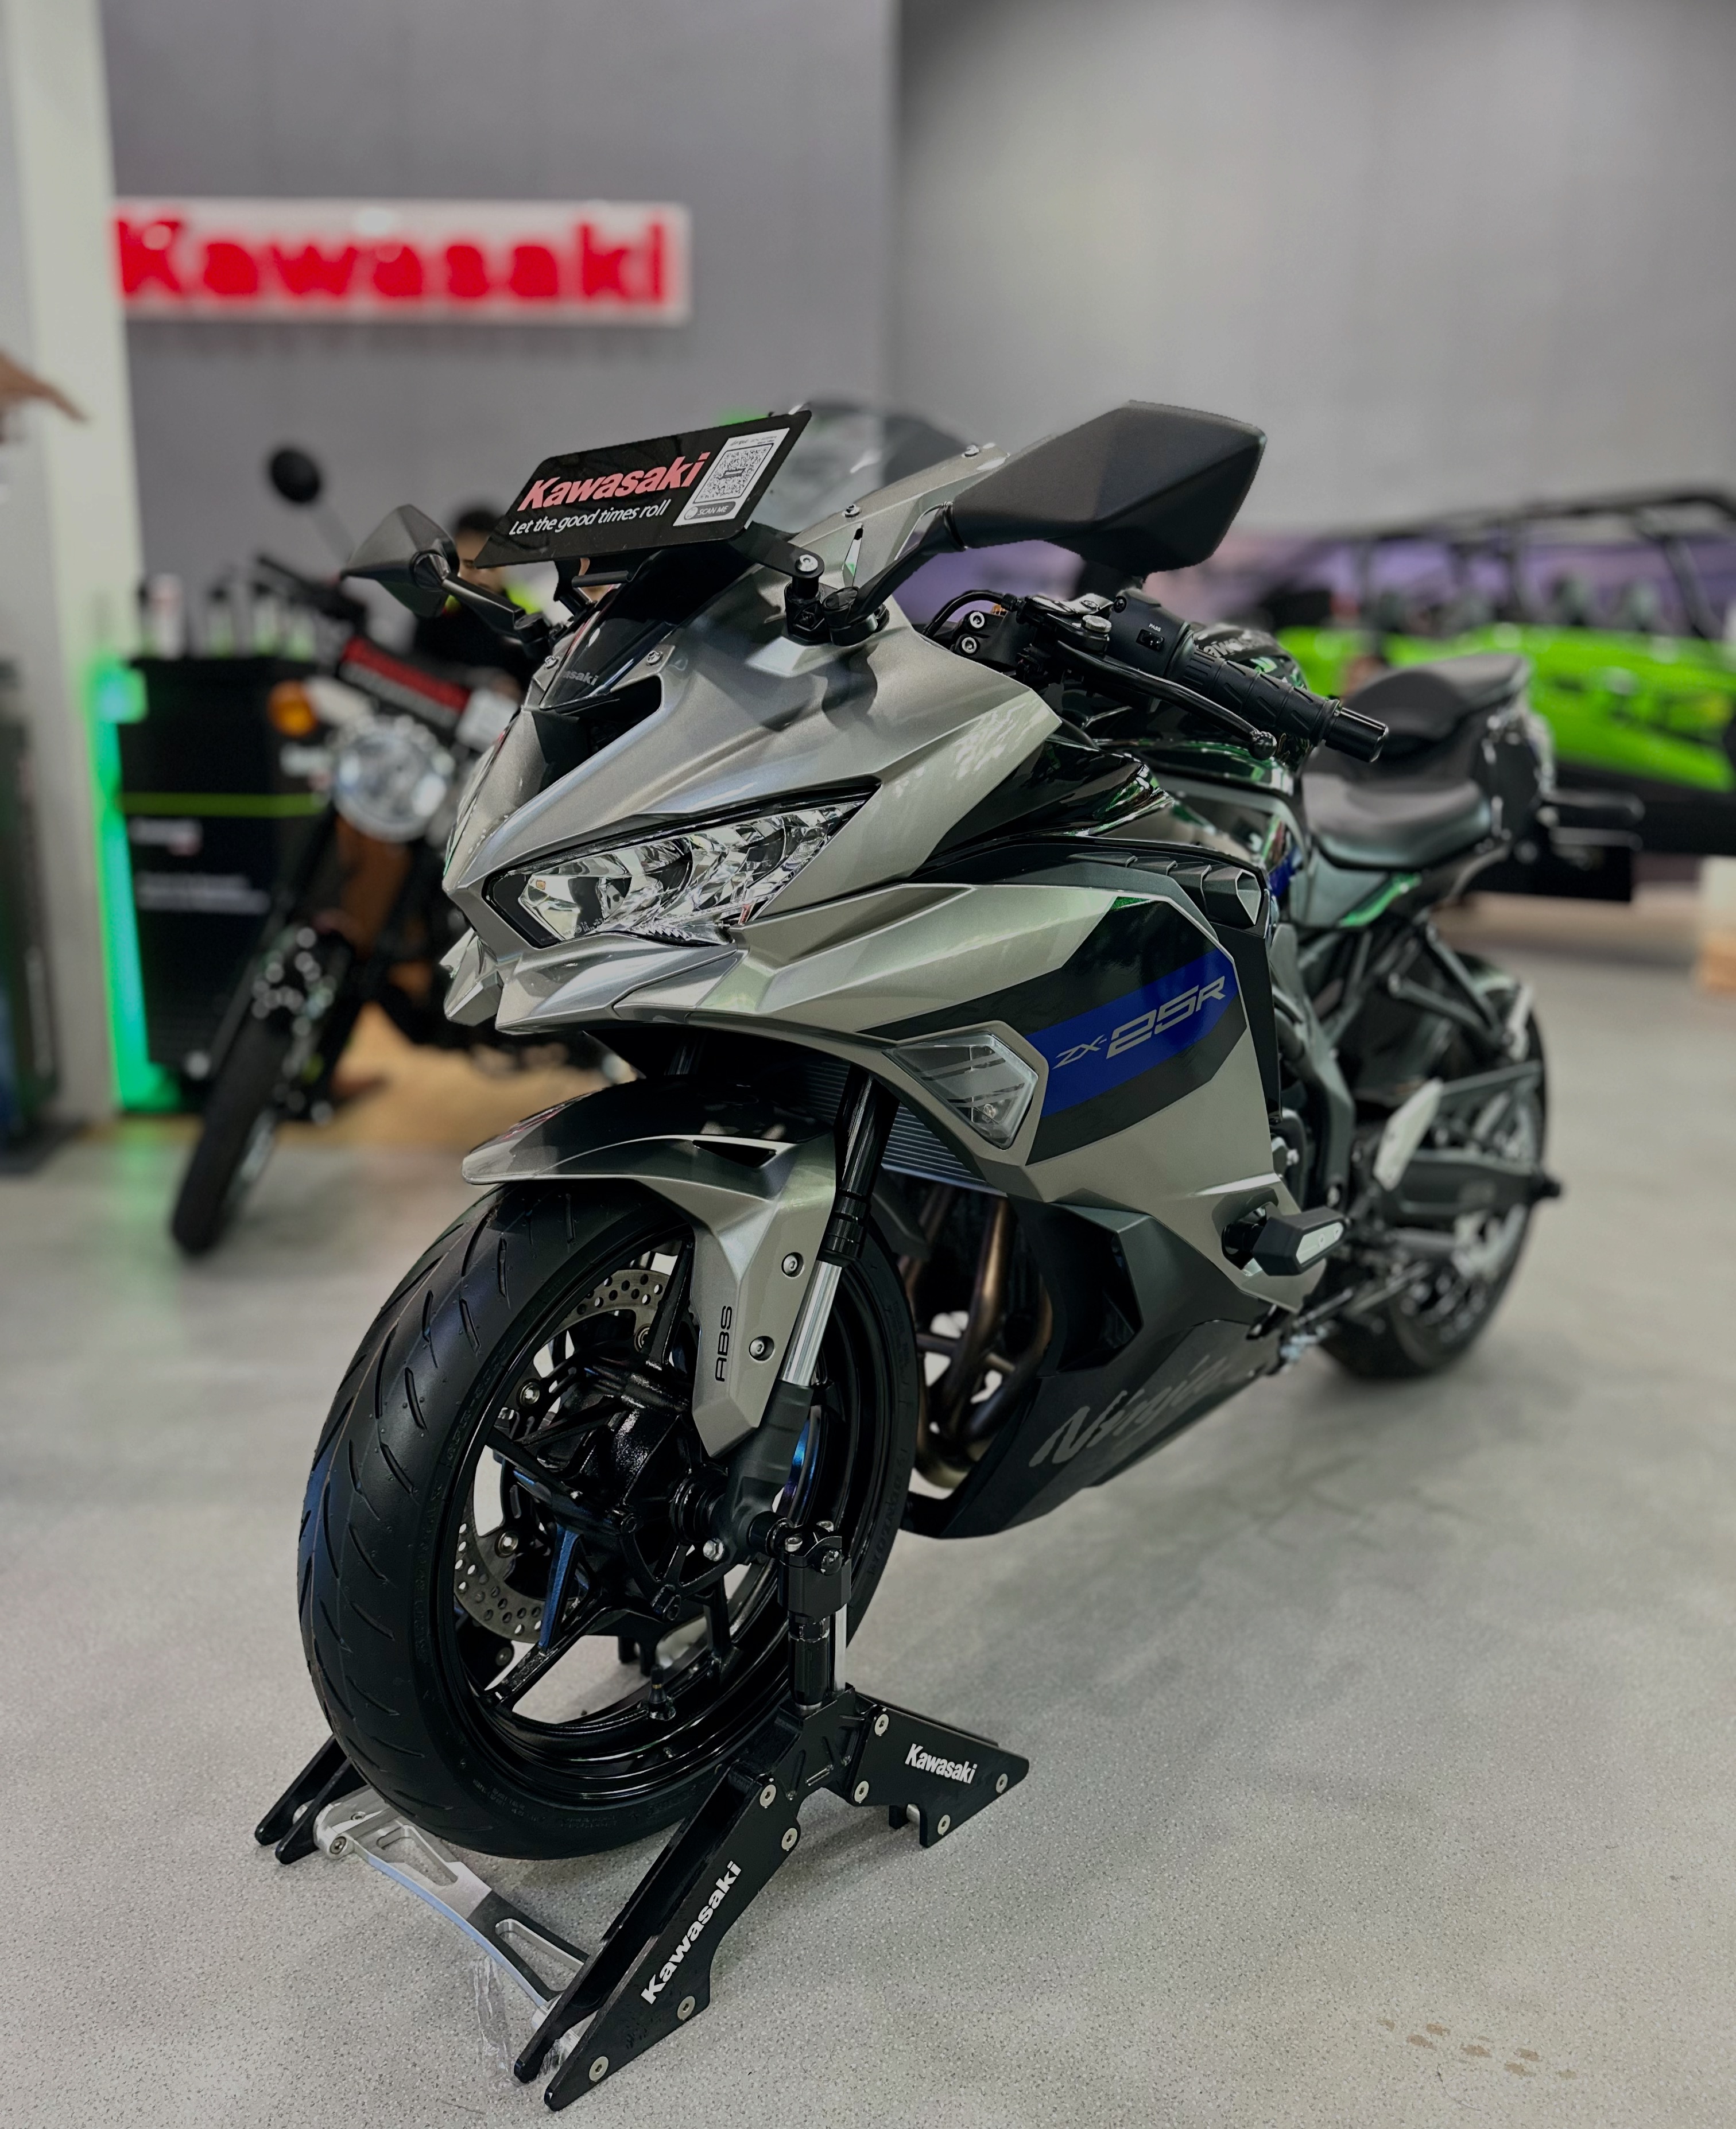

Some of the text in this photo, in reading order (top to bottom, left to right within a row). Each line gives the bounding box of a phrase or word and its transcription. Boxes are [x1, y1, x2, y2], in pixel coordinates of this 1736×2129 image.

[116, 219, 666, 298] Kawasaki
[517, 452, 711, 511] Kawasaki
[698, 505, 729, 516] SCAN ME
[509, 498, 672, 535] Let the good times roll
[1148, 623, 1162, 633] PASS
[1052, 975, 1226, 1070] ZX-25R
[715, 1305, 733, 1382] ABS
[905, 1743, 978, 1785] Kawasaki
[640, 1860, 742, 2004] Kawasaki
